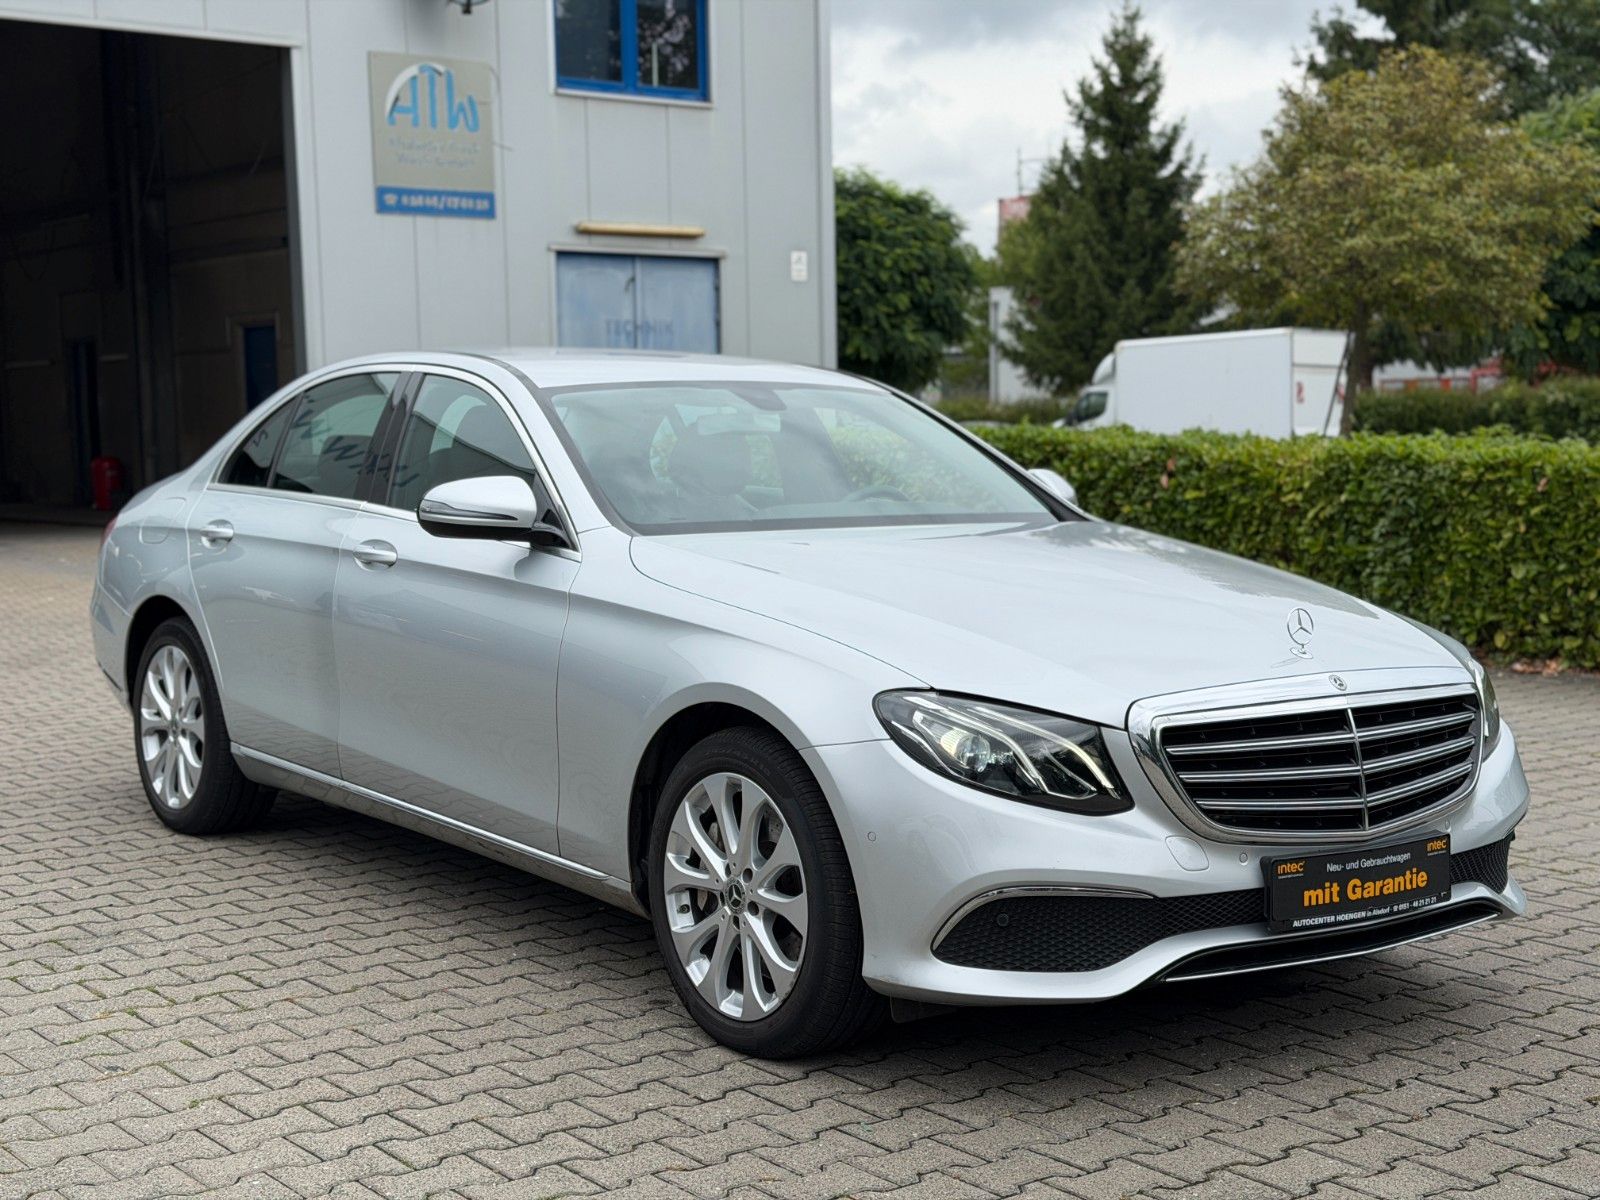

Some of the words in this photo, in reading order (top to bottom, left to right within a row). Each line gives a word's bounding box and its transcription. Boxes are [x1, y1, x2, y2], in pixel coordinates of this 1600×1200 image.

[1427, 840, 1448, 851] intec
[1277, 860, 1304, 874] intec
[1326, 862, 1344, 872] Neu-
[1346, 860, 1359, 870] und
[1360, 852, 1411, 868] Gebrauchtwagen
[1303, 881, 1340, 907] mit
[1346, 867, 1428, 901] Garantie
[1292, 915, 1335, 927] AUTOCENTER
[1336, 910, 1366, 921] HOENGEN
